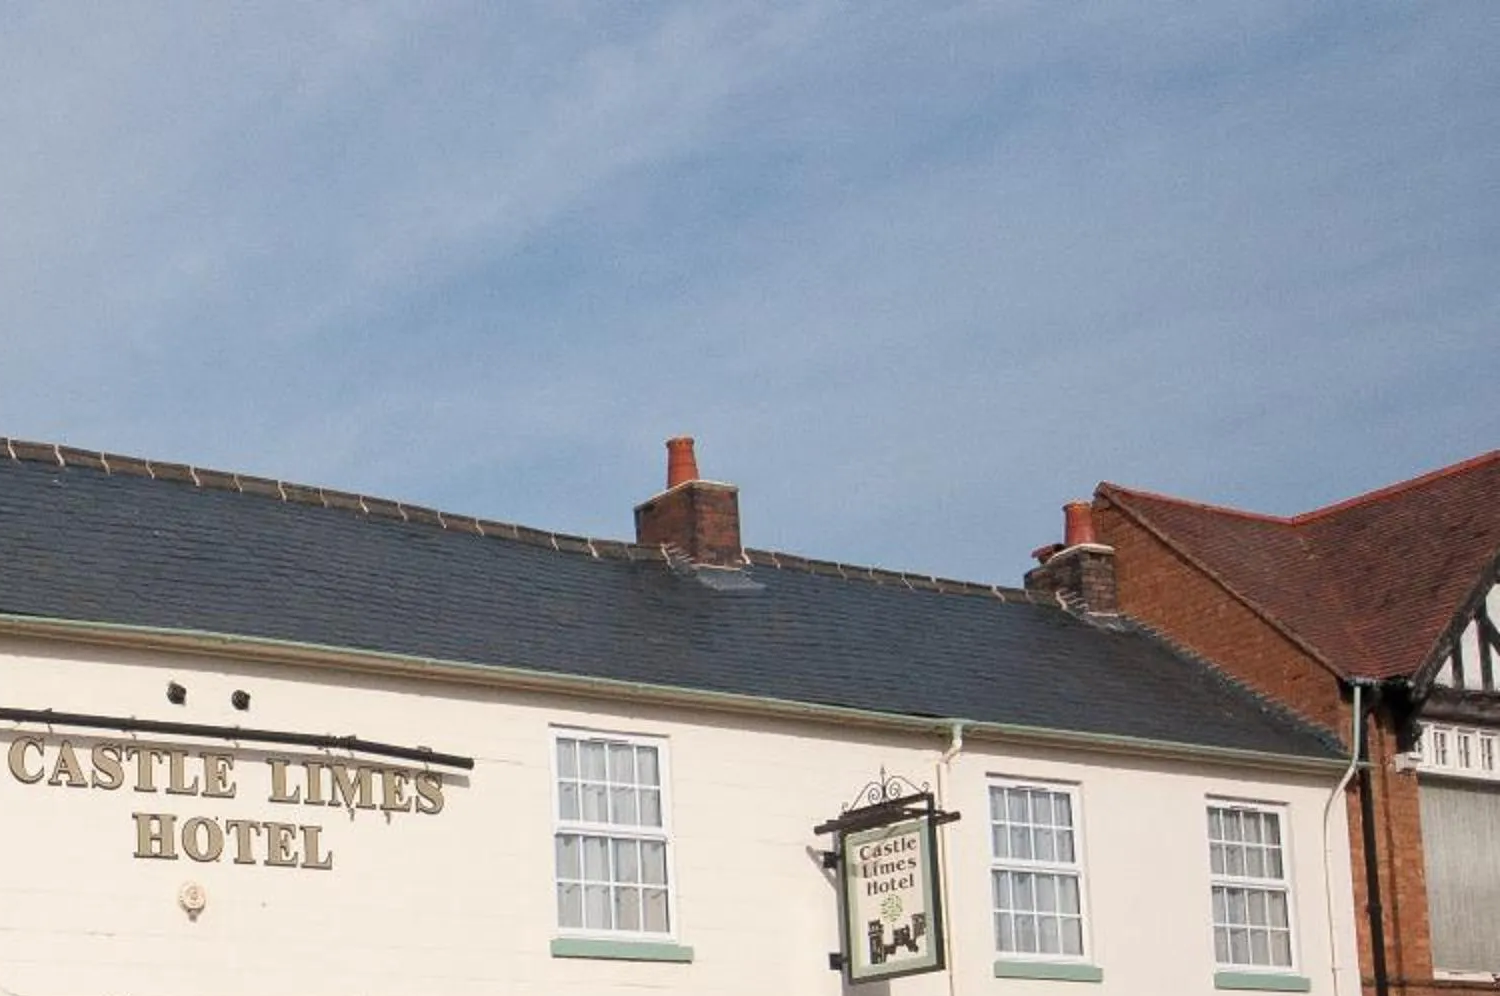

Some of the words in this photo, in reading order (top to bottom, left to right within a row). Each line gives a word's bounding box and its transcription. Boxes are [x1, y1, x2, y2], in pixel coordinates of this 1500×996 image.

[7, 735, 237, 799] CASTLE
[266, 757, 446, 815] LIMES
[132, 811, 333, 871] HOTEL
[859, 837, 917, 860] Castle
[863, 857, 917, 879] Limes
[867, 873, 914, 896] Hotel
